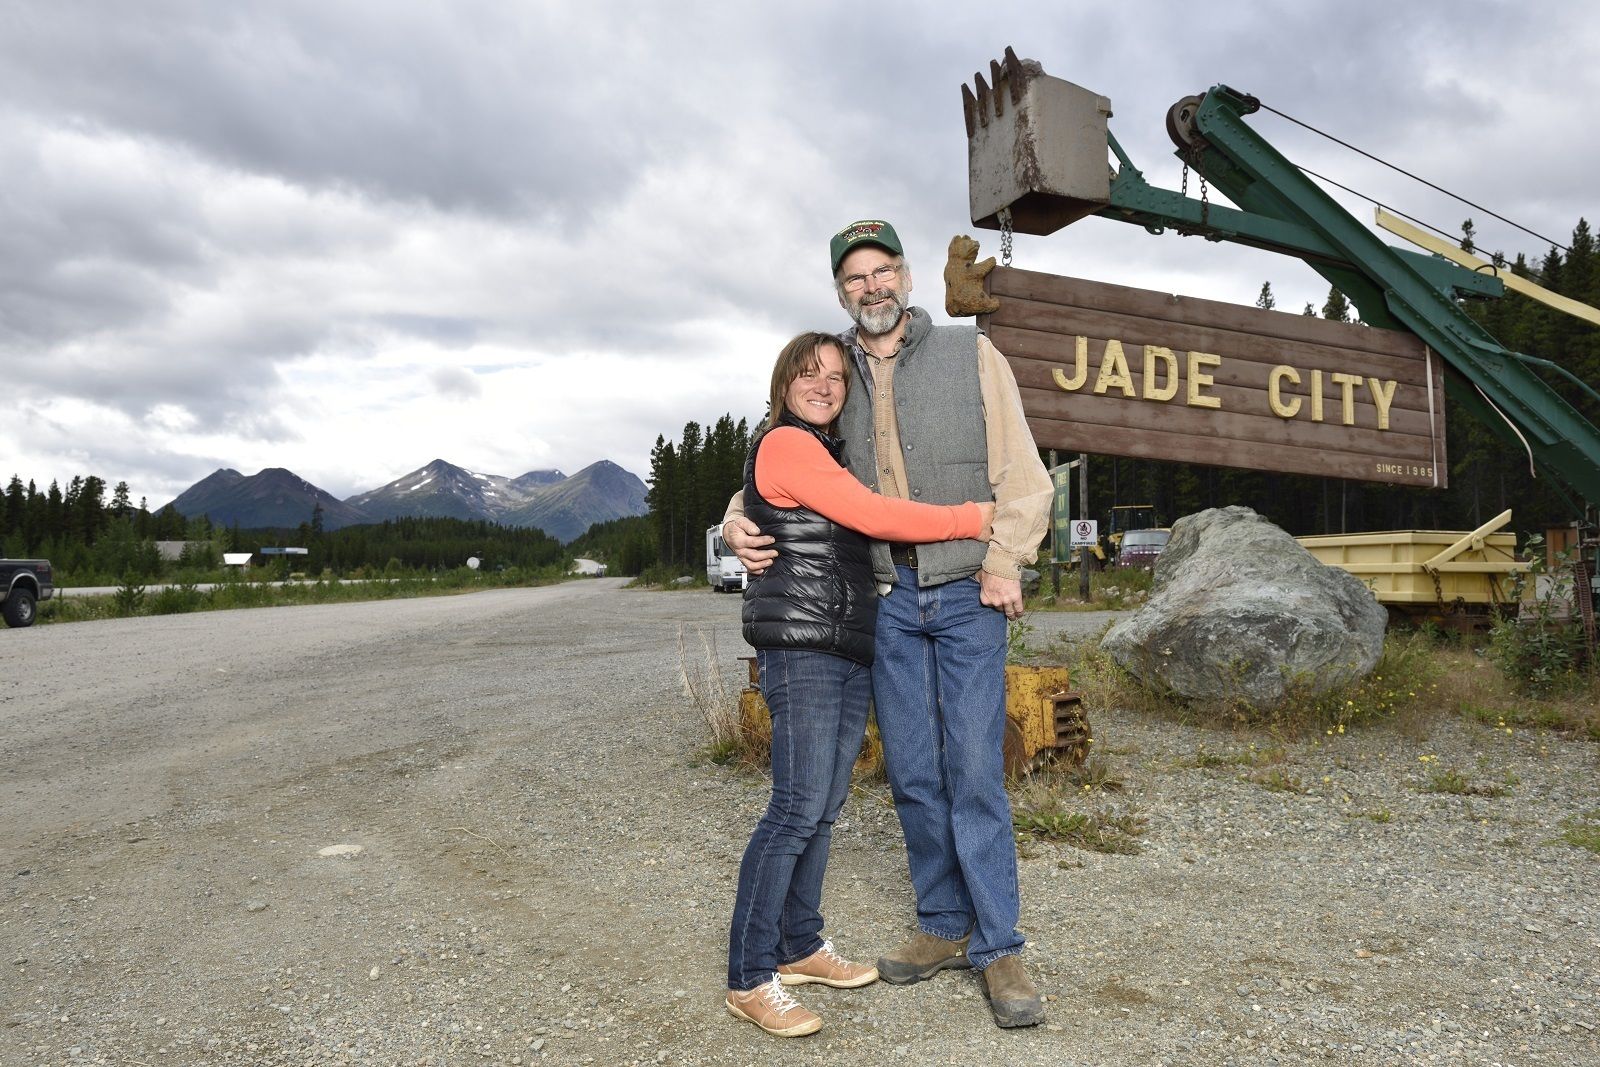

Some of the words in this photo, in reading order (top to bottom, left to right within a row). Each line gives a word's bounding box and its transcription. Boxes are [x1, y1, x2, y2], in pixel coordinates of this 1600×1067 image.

[1051, 335, 1222, 408] JADE
[1268, 364, 1398, 430] CITY
[1376, 463, 1403, 475] SINCE
[1406, 465, 1433, 478] 1985
